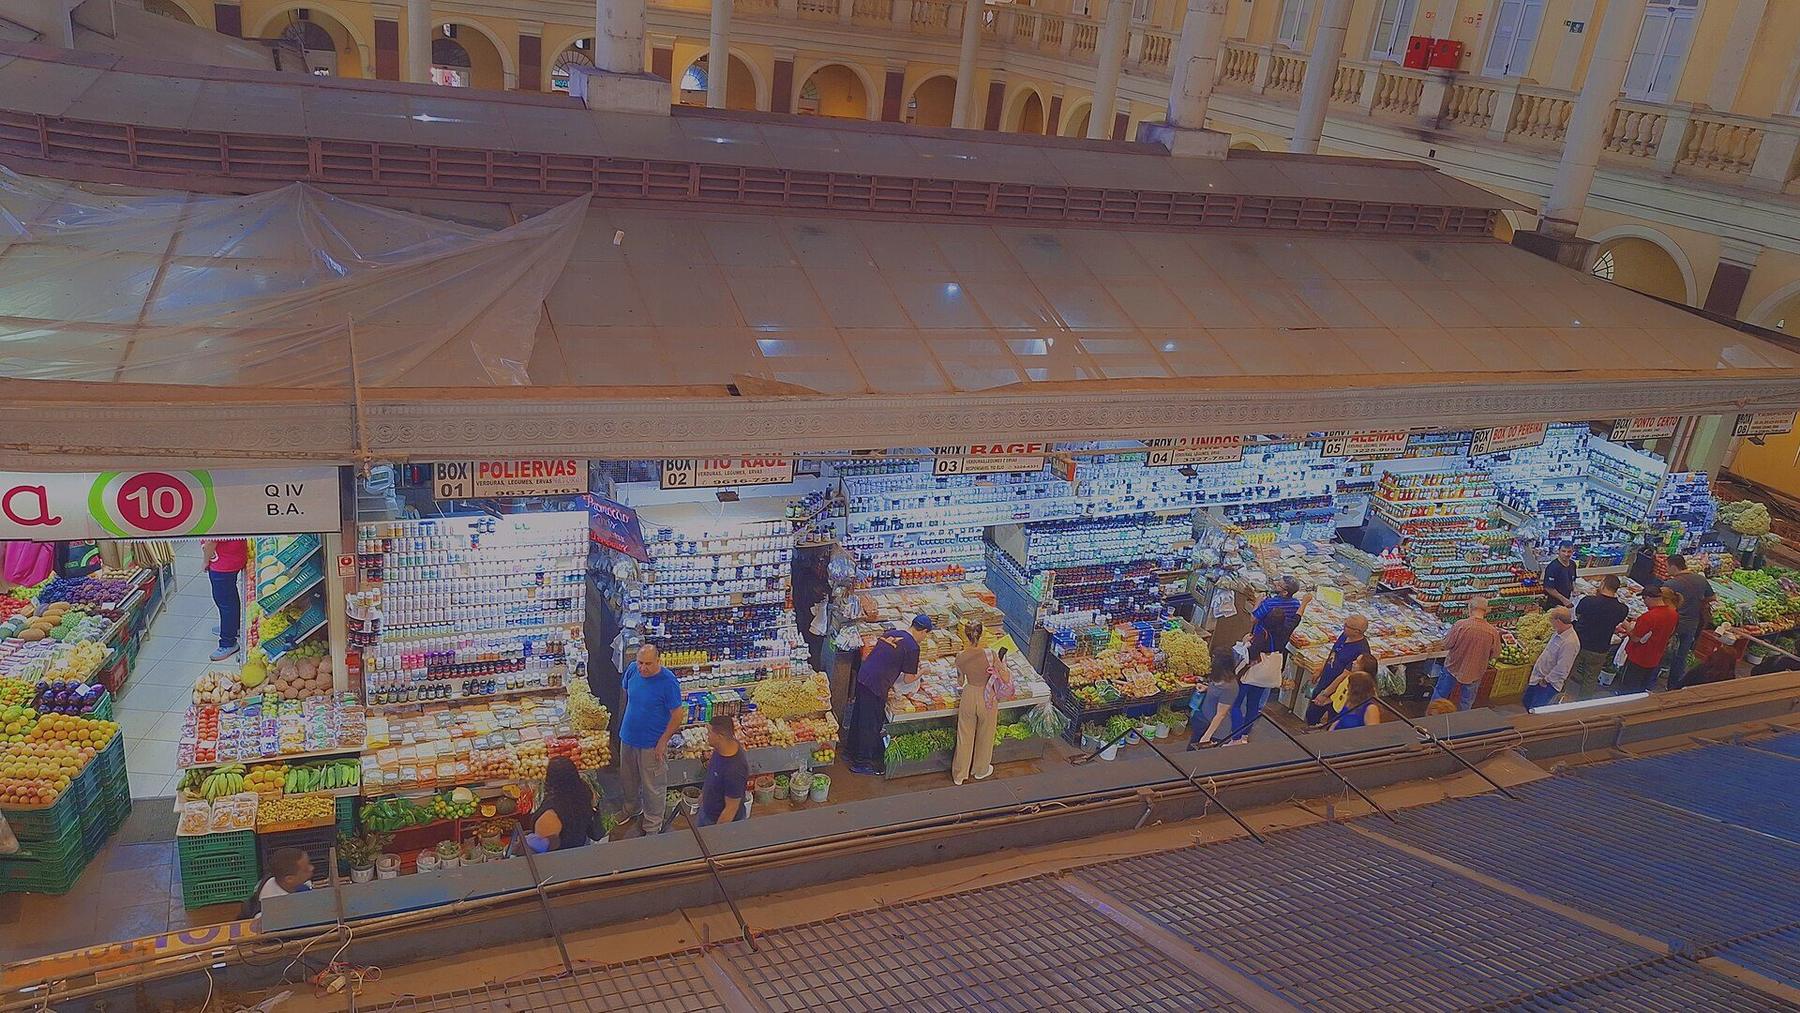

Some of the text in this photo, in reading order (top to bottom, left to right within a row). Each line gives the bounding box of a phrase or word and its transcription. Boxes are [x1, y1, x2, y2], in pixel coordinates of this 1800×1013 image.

[1615, 418, 1630, 429] BOX
[1632, 416, 1679, 428] PONTO CERTO
[1474, 430, 1491, 443] BOX
[1612, 430, 1625, 440] 07
[1326, 443, 1341, 454] 05
[1152, 452, 1168, 464] 04
[437, 462, 467, 481] BOX
[479, 460, 577, 479] POLIERVAS
[666, 459, 692, 471] BOX
[938, 460, 958, 473] 03
[668, 473, 687, 486] 02
[265, 483, 305, 498] Q IV
[440, 483, 464, 497] 01
[125, 486, 183, 519] 10
[266, 502, 305, 516] B.A.
